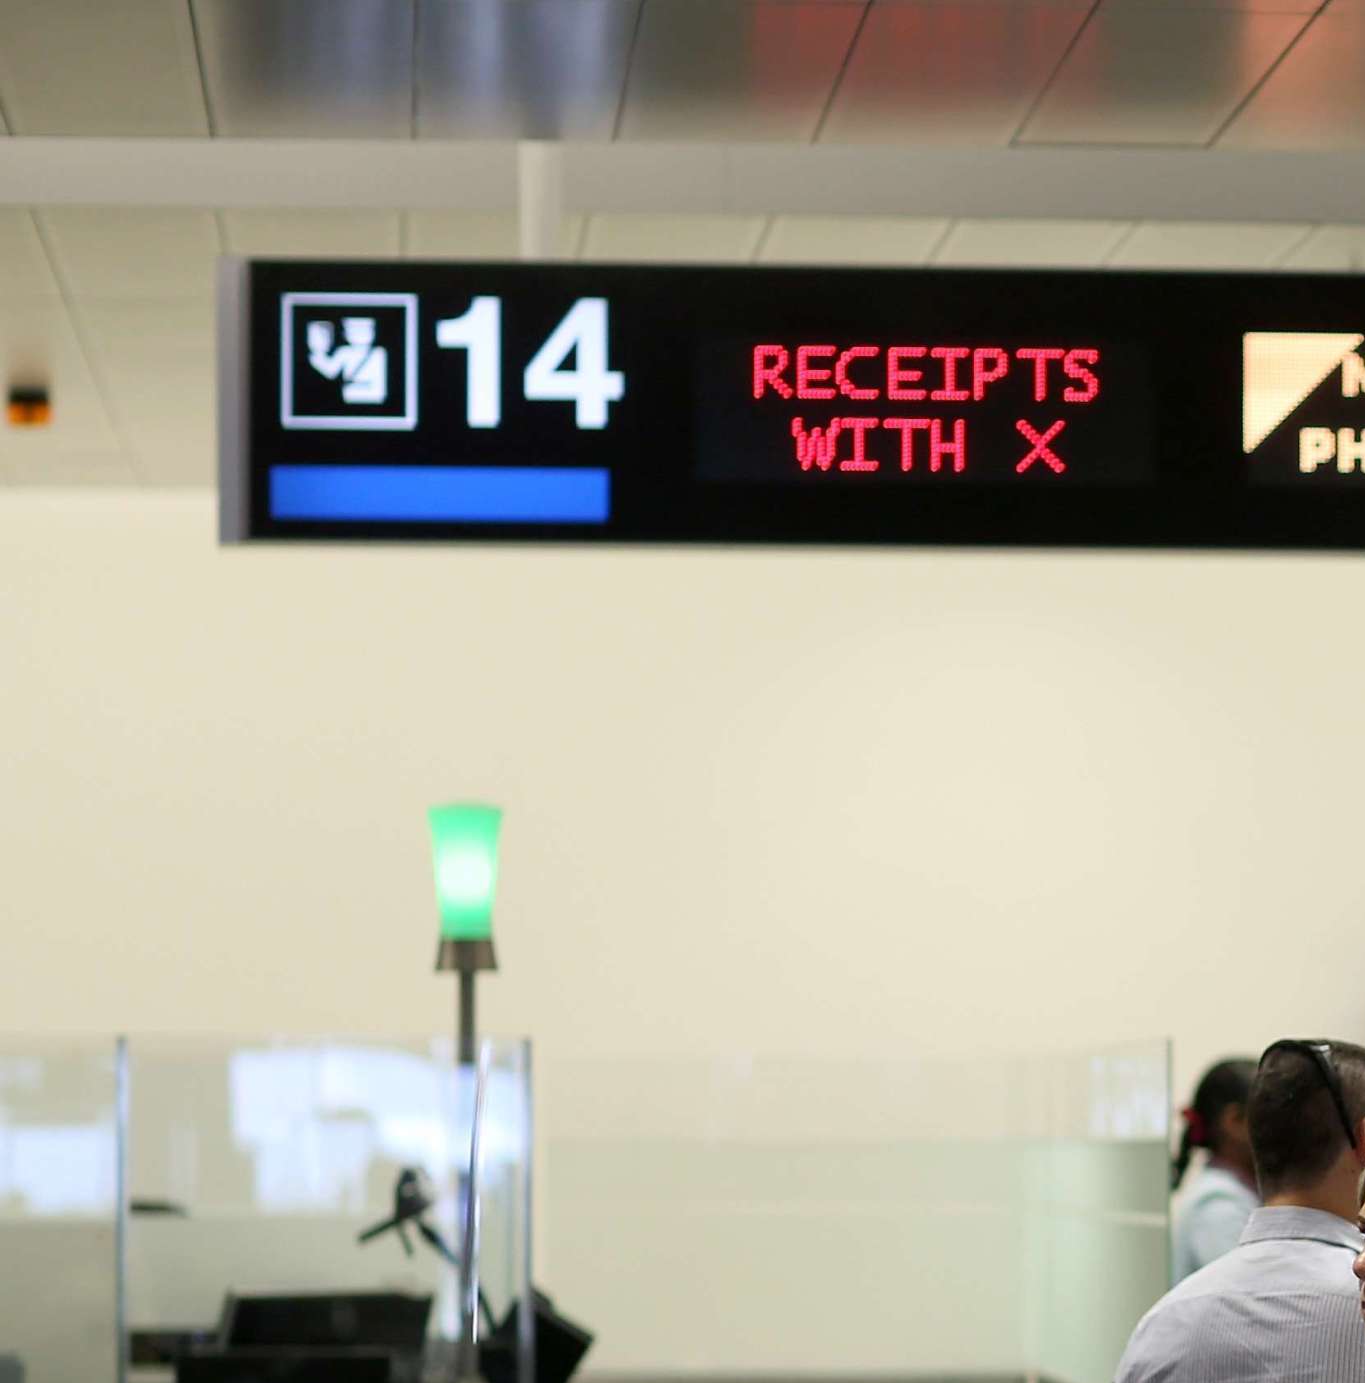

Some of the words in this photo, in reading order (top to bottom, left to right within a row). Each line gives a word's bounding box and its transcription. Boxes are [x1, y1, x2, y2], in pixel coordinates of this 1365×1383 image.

[436, 296, 625, 428] 14
[752, 344, 1100, 402] RECEIPTS
[790, 416, 966, 473] WITH
[1015, 419, 1066, 474] X
